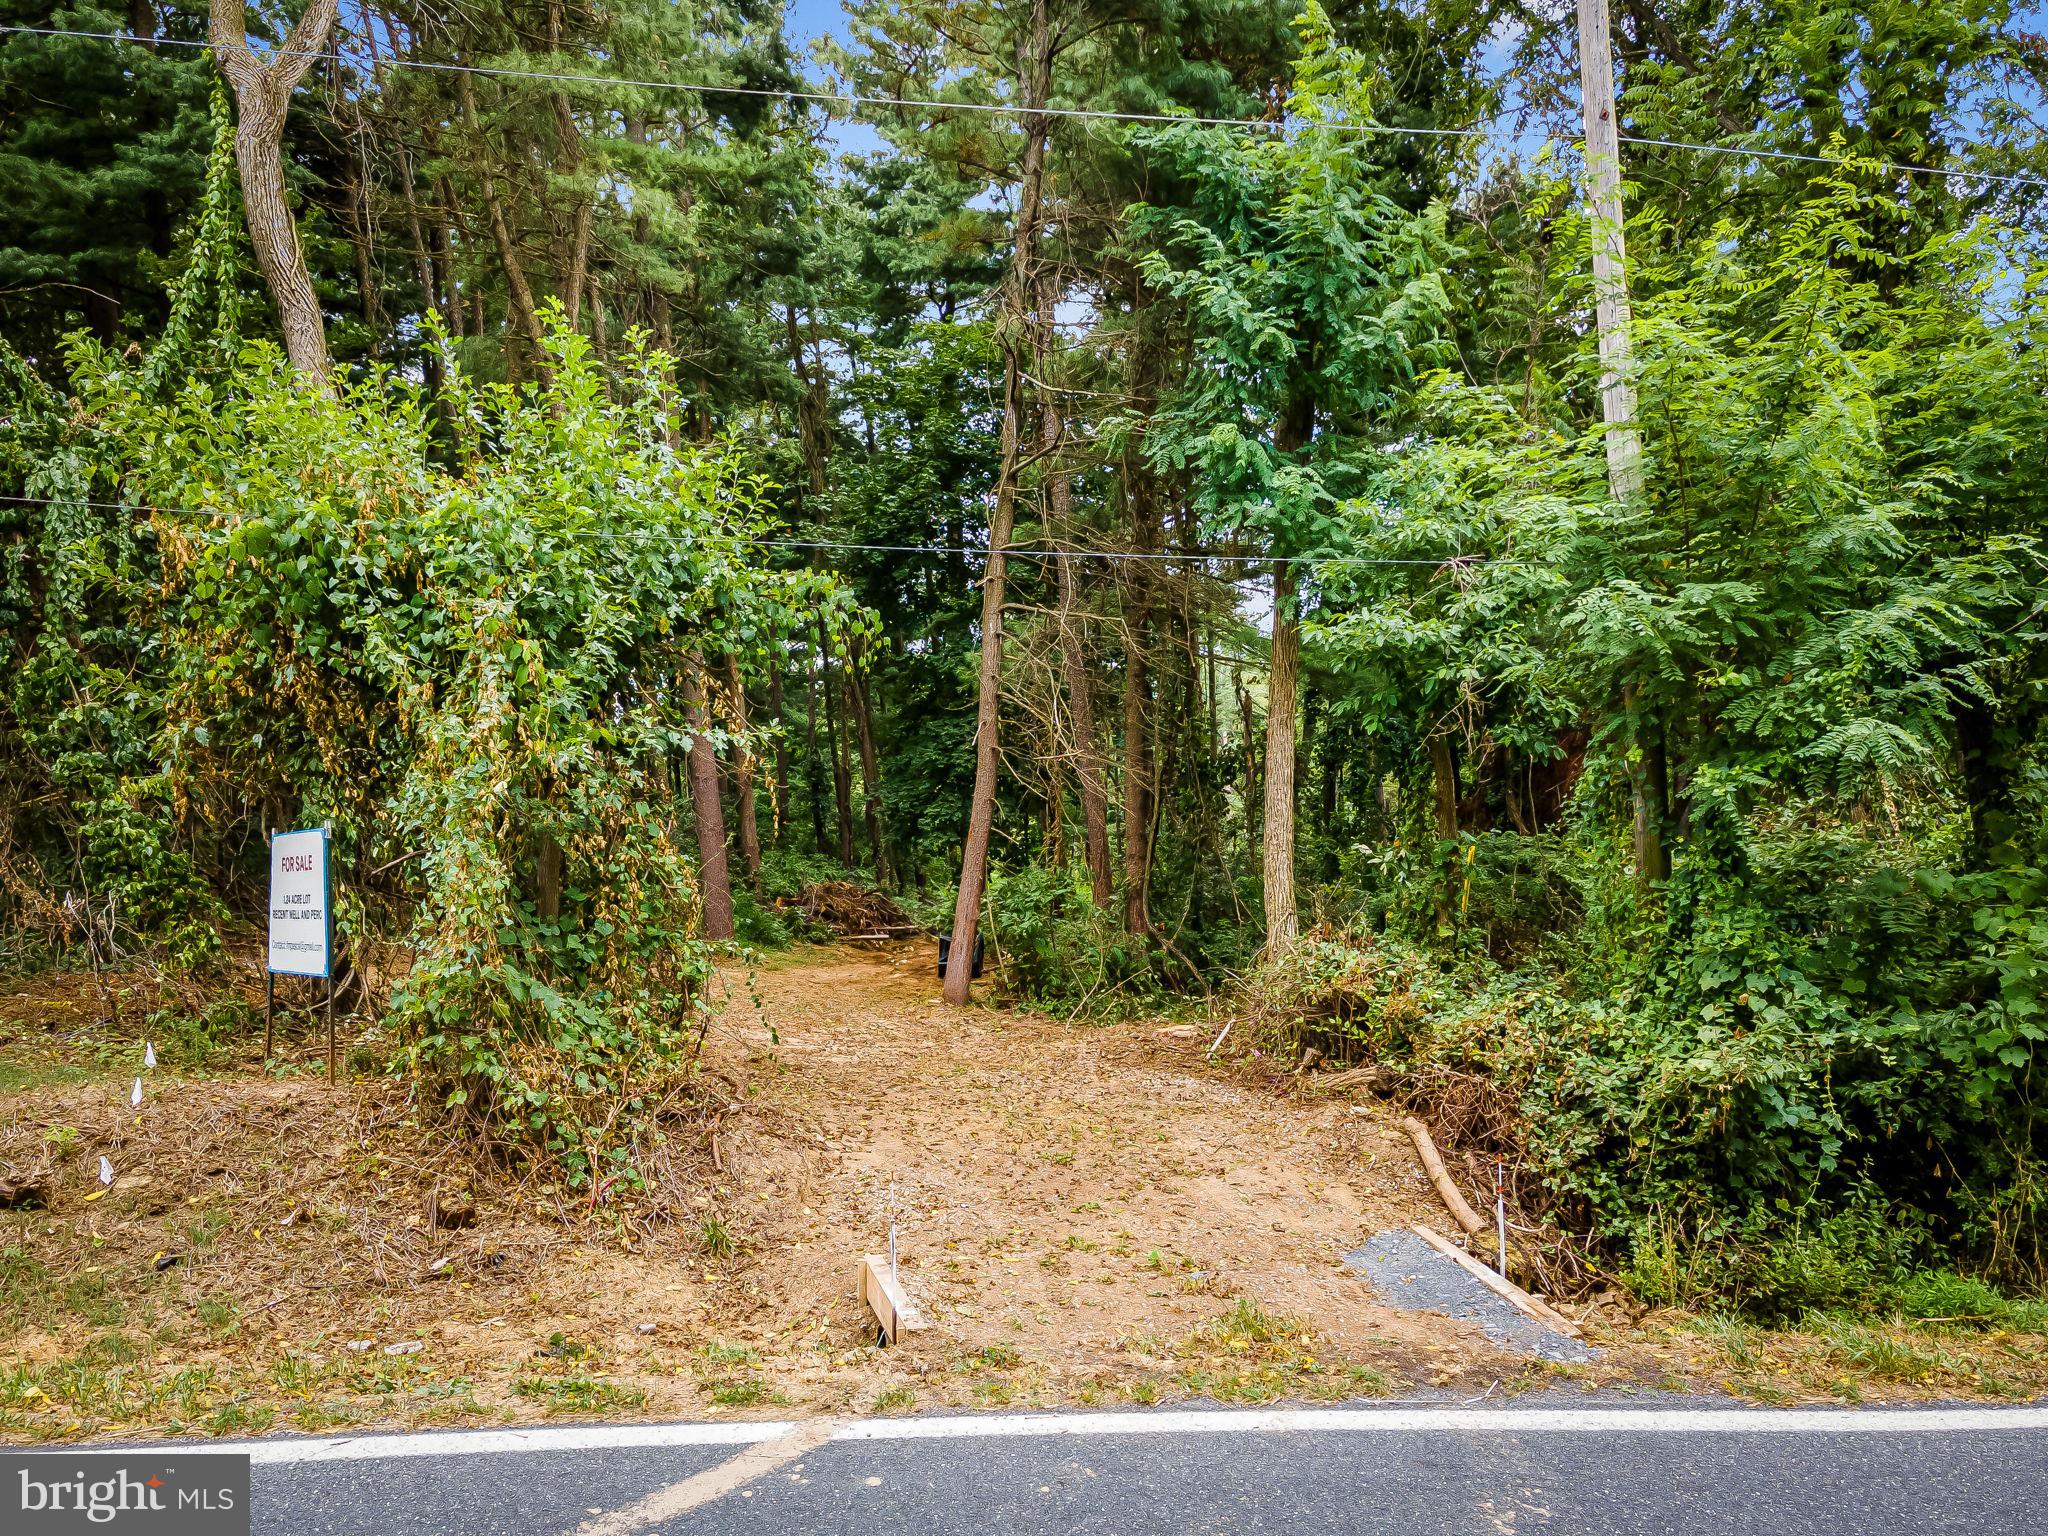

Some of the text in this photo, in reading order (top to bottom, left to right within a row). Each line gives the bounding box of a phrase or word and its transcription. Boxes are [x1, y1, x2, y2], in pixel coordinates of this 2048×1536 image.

[282, 855, 312, 872] FOR SALE
[291, 894, 302, 904] ACRE
[303, 894, 311, 904] LOT
[273, 910, 322, 919] RECENT WELL AND PERC
